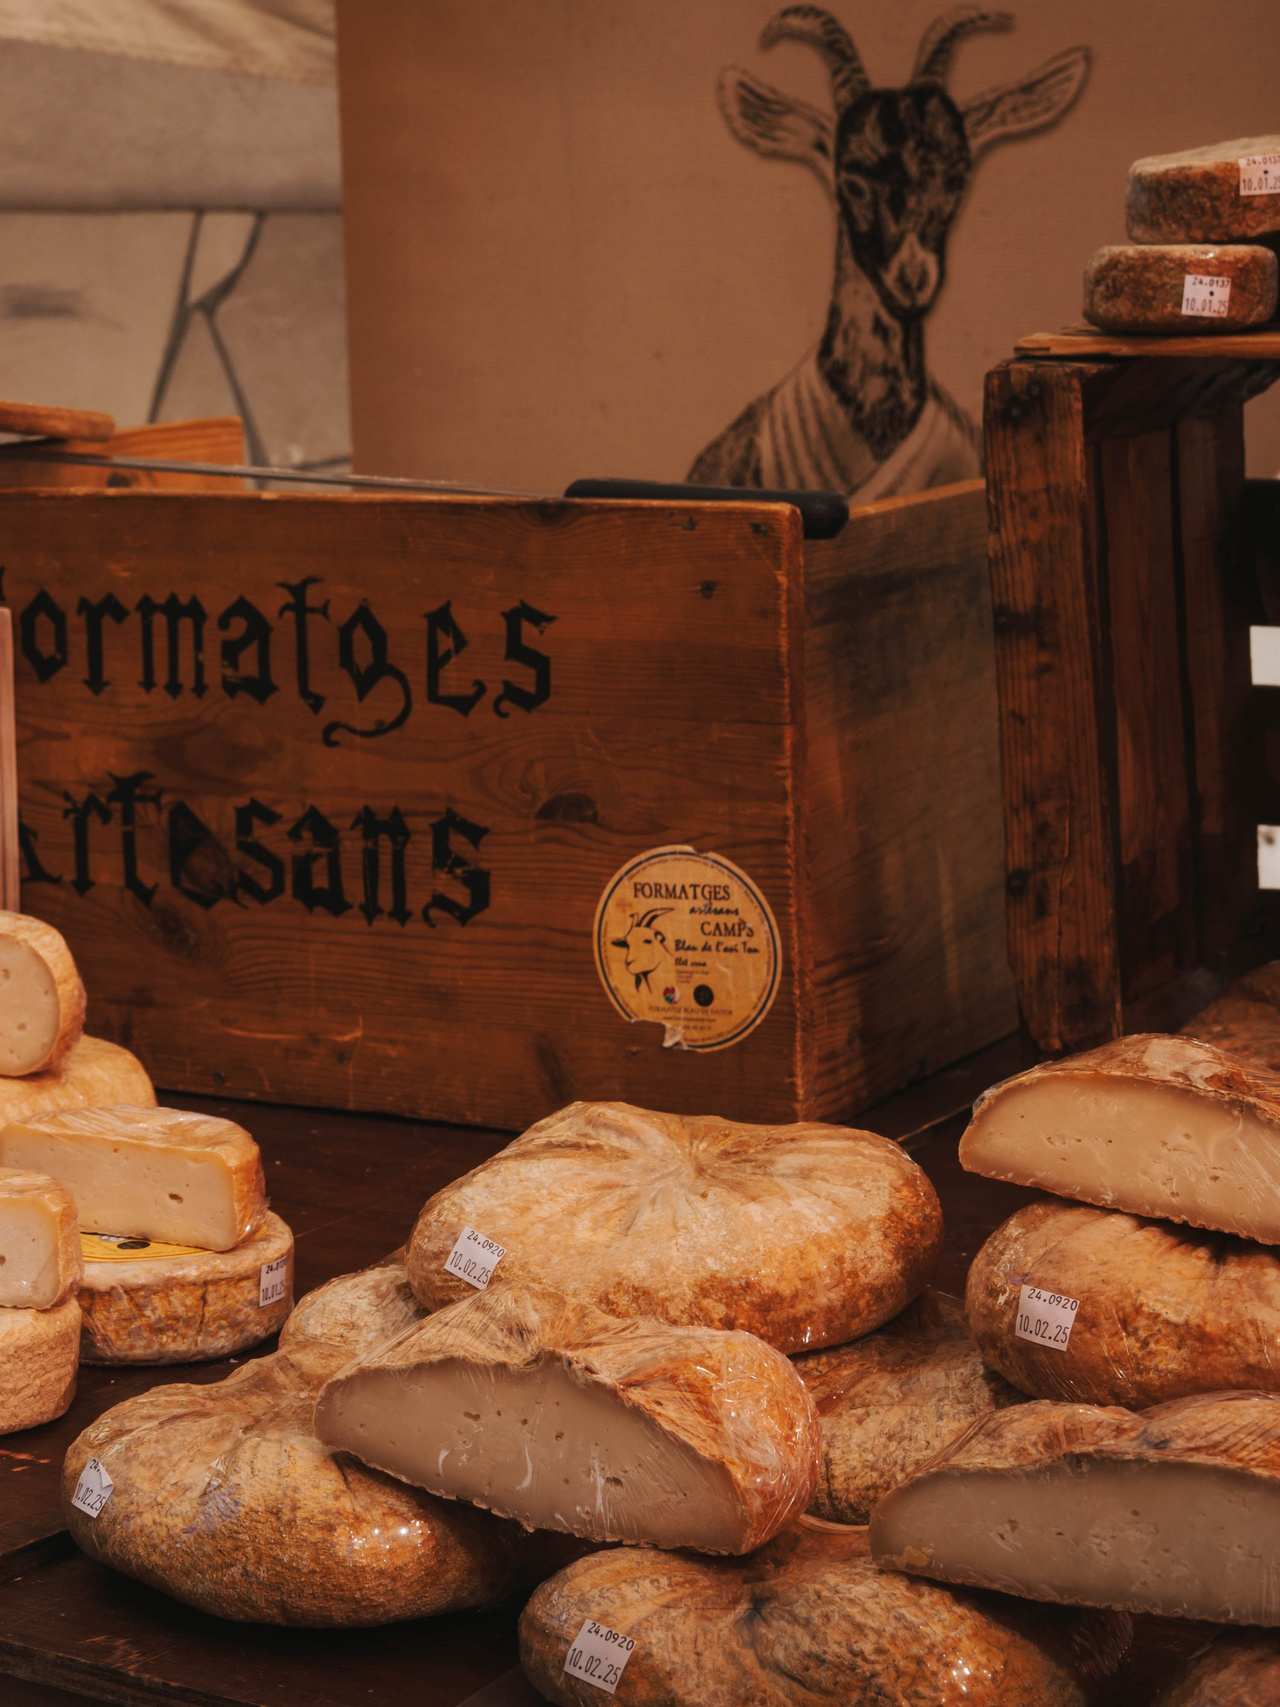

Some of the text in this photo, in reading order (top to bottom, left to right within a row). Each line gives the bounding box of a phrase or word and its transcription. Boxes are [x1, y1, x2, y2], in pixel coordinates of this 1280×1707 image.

[1185, 298, 1227, 315] 10.01.25
[633, 882, 731, 904] FORMATGES
[700, 920, 755, 938] CAMPS
[467, 1230, 505, 1258] 24.0920
[449, 1250, 491, 1285] 10.02.25
[1028, 1288, 1078, 1311] 24.0920
[1020, 1314, 1069, 1343] 10.02.25
[587, 1622, 635, 1651] 24.0920
[568, 1647, 622, 1685] 10.02.25
